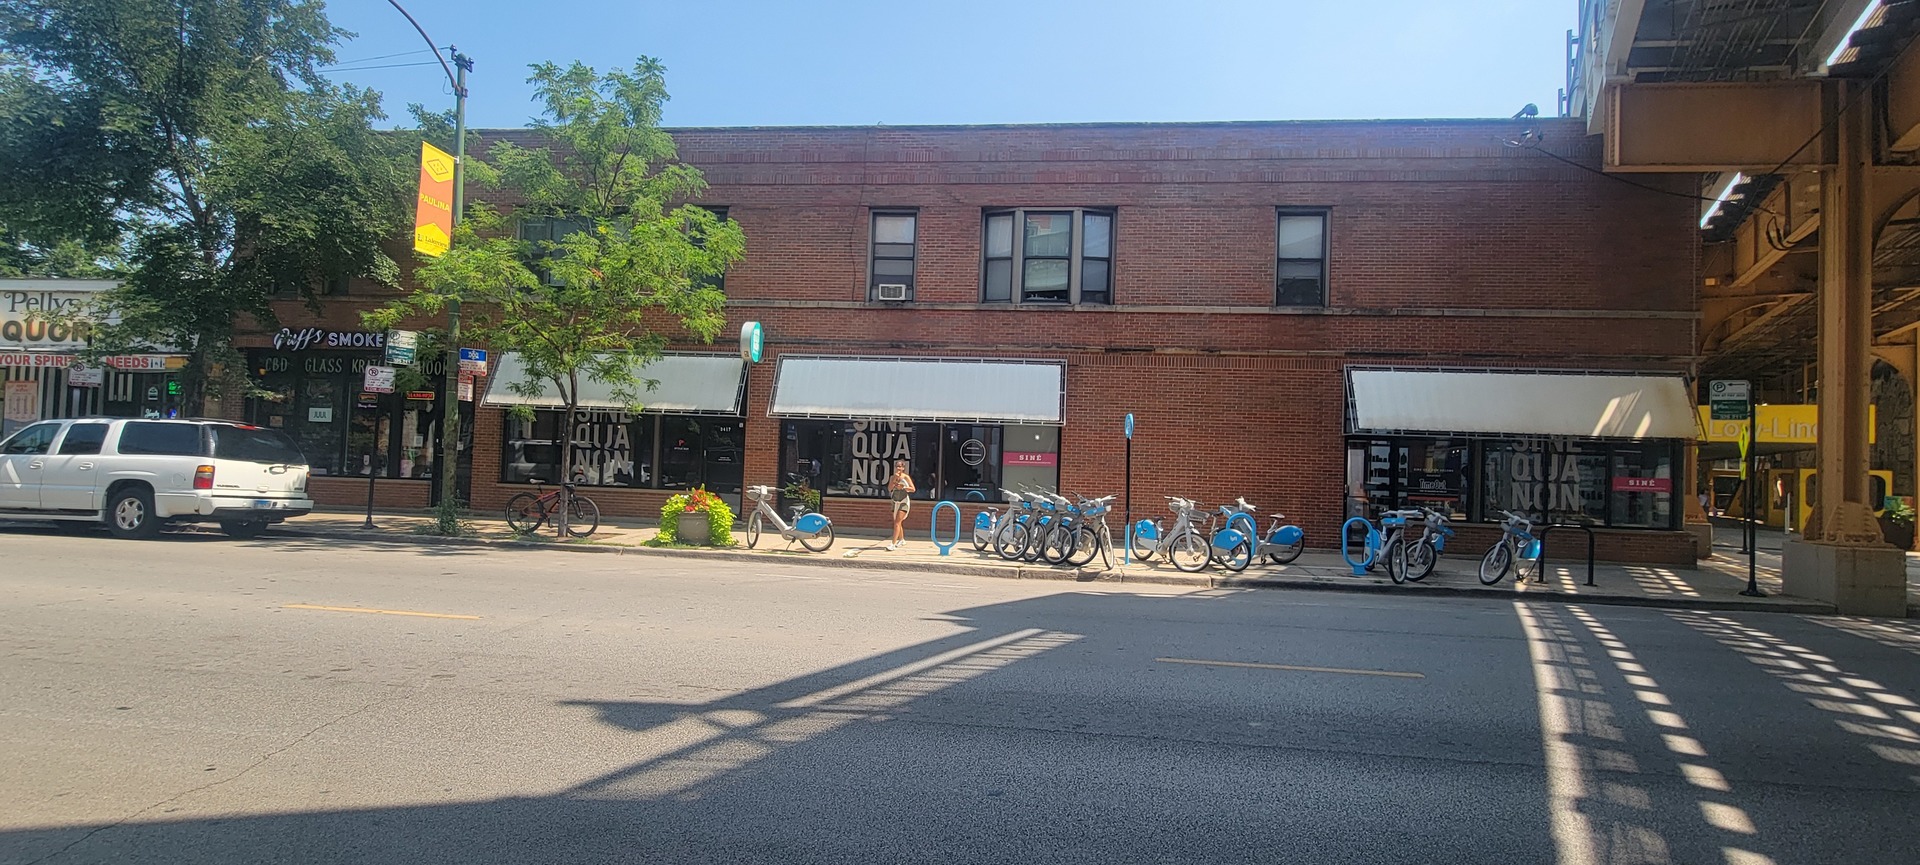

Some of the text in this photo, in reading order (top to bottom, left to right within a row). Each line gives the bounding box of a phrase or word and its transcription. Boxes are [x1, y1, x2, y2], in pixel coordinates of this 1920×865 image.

[420, 194, 449, 212] PAULINA
[274, 327, 384, 351] Puffs SMOKE
[106, 356, 149, 368] NEEDS
[265, 358, 288, 372] CBD
[305, 358, 342, 373] GLASS
[575, 424, 630, 449] QUA
[852, 432, 911, 458] QUA
[575, 449, 630, 474] NON
[1511, 452, 1580, 482] QUA
[1511, 482, 1580, 512] NON
